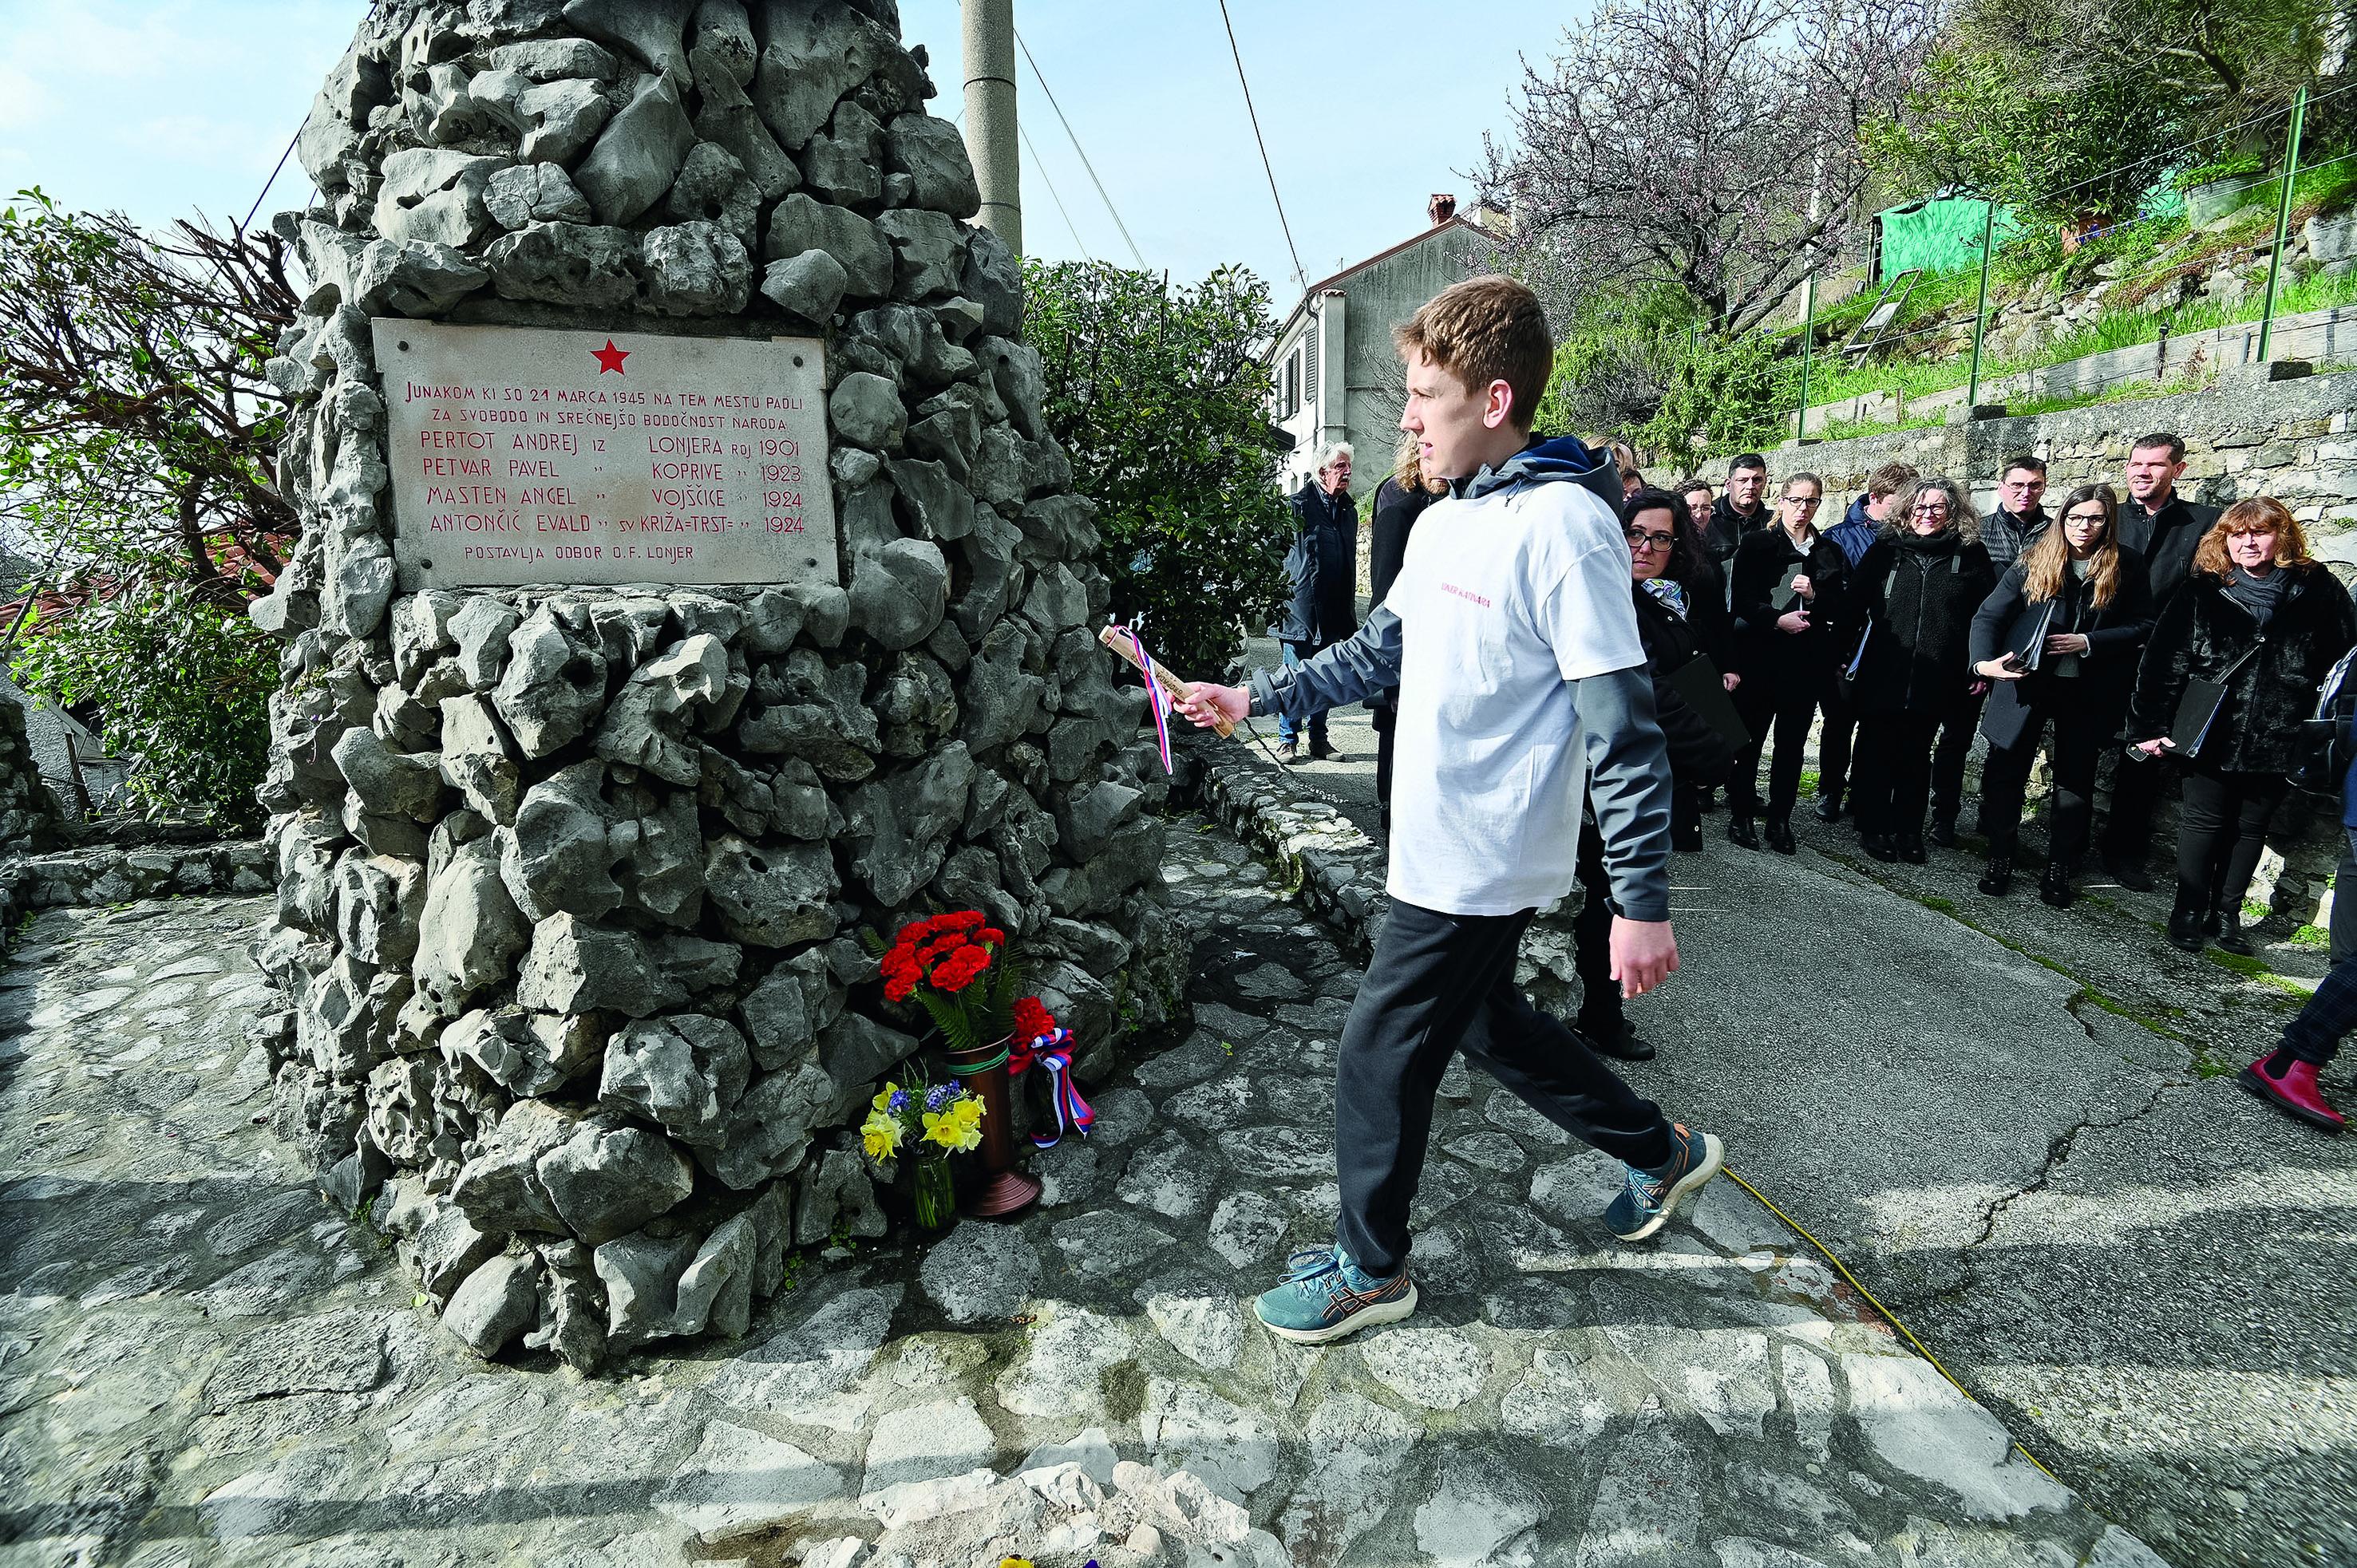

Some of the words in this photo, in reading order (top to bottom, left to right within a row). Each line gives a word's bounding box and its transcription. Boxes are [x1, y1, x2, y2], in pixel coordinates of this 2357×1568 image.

[483, 388, 496, 400] KI
[504, 389, 522, 401] SO
[530, 389, 549, 402] 21
[557, 391, 607, 405] MARCA
[613, 392, 645, 404] 1945
[654, 393, 671, 405] NA
[678, 393, 706, 406] TEM
[714, 396, 759, 409] MESTU
[433, 409, 451, 421] ZA
[461, 409, 527, 422] SVOBODO
[537, 412, 549, 424] IN
[557, 408, 635, 430] SREČNEJŠO
[644, 412, 725, 429] BODOČNOST
[733, 417, 786, 430] NARODA
[421, 431, 495, 449] PERTOT
[512, 433, 577, 456] ANDREJ
[592, 440, 606, 452] IZ
[649, 436, 722, 457] LONJERA
[732, 444, 751, 459] ROJ
[759, 439, 798, 456] 1901
[423, 458, 491, 476] PETVAR
[509, 460, 559, 477] PAVEL
[653, 463, 722, 480] KOPRIVE
[761, 465, 801, 482] 1923
[427, 486, 506, 504] MASTEN
[520, 487, 576, 504] ANGEL
[763, 491, 802, 508] 1924
[430, 510, 520, 531] ANTONČIČ
[538, 515, 590, 531] EVALD
[765, 517, 804, 532] 1924
[465, 547, 544, 563] POSTAVLJA
[556, 547, 602, 559] ODBOR
[647, 547, 693, 564] LONJER
